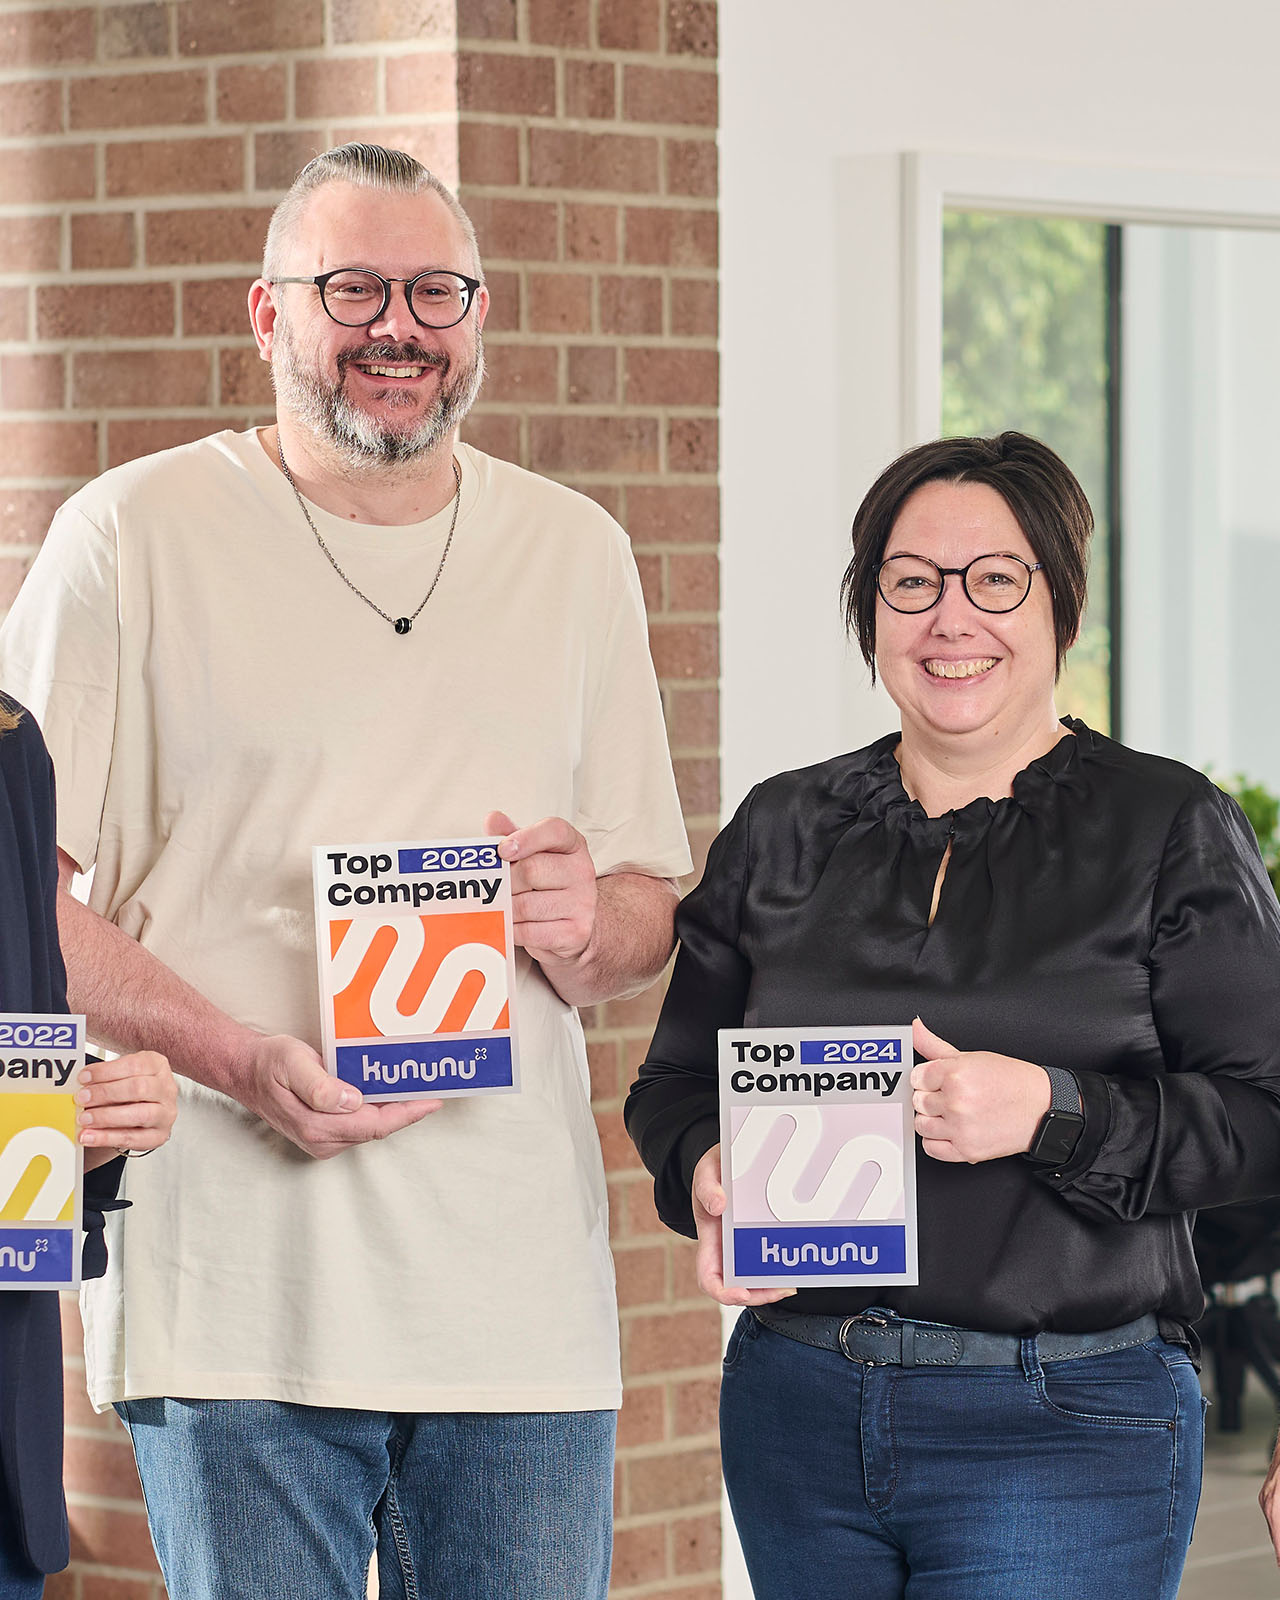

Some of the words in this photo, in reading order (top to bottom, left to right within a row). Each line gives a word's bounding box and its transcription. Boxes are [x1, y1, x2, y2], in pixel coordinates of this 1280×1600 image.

[327, 852, 392, 878] Top
[422, 847, 498, 870] 2023
[327, 877, 503, 908] Company
[731, 1041, 795, 1067] Top
[823, 1042, 898, 1062] 2024
[362, 1055, 477, 1084] kununu
[730, 1069, 902, 1097] Company
[761, 1237, 879, 1267] kununu
